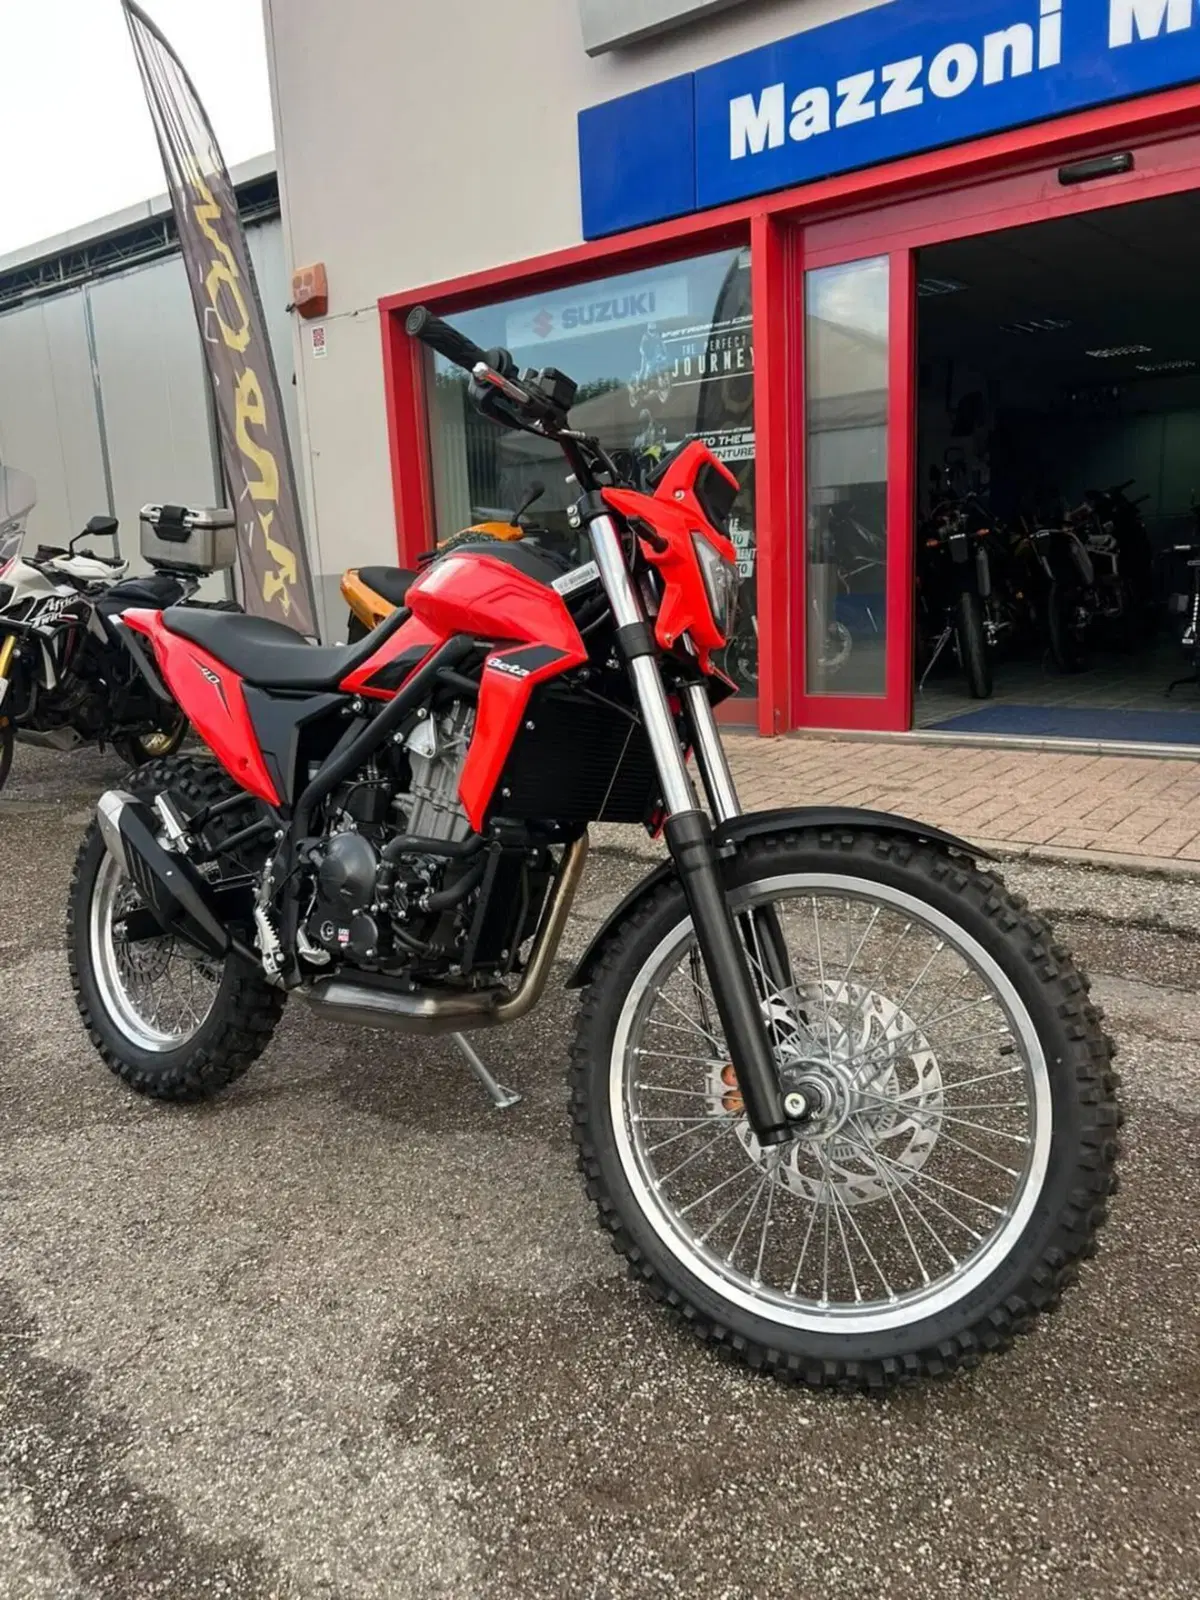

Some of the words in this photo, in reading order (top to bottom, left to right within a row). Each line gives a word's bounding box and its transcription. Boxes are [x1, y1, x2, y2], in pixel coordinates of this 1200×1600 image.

[729, 0, 1062, 161] Mazzoni
[562, 292, 656, 329] SUZUKI
[682, 343, 695, 356] THE
[704, 334, 747, 351] PERFECT
[718, 433, 741, 446] THE
[36, 594, 79, 616] Africa
[30, 612, 61, 628] Twin
[487, 657, 530, 676] Beta
